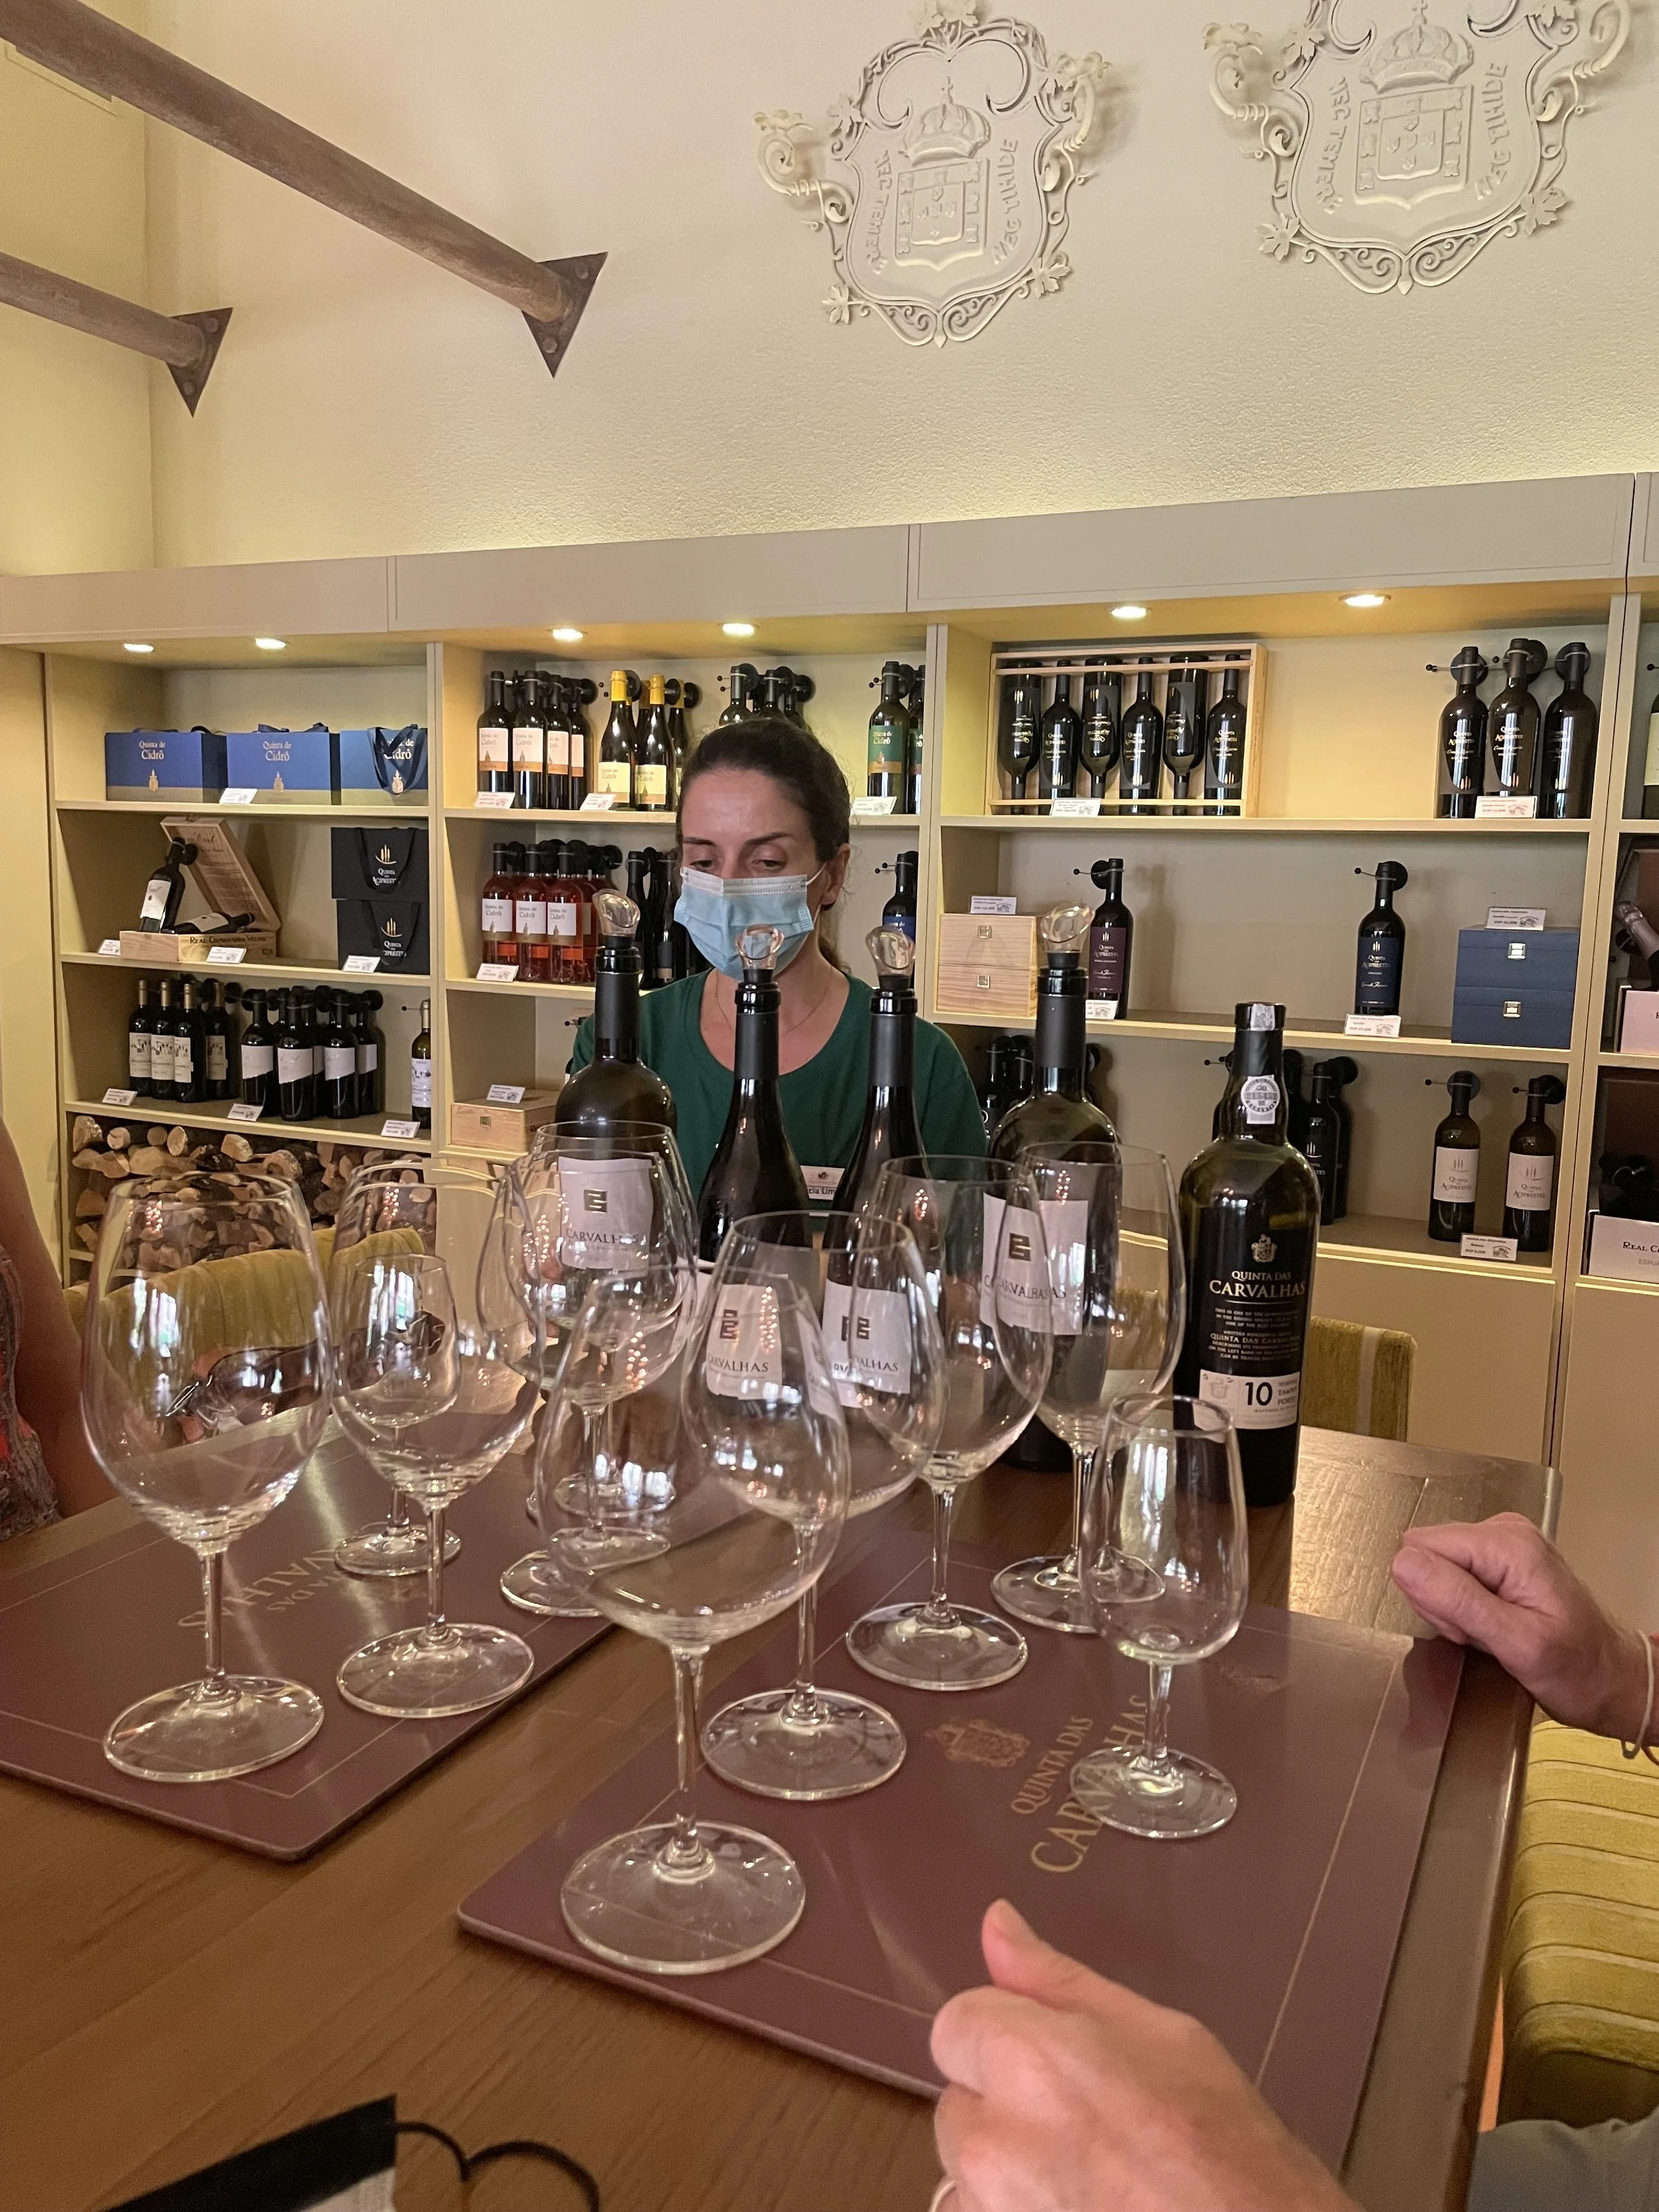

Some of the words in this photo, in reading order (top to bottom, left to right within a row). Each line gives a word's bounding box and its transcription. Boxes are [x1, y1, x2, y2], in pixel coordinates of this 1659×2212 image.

[139, 741, 158, 749] Quinta
[263, 741, 283, 750] Quinta
[141, 749, 165, 760] Cidrô
[265, 750, 290, 761] Cidrô
[566, 1228, 638, 1244] CARVALHS
[1623, 1242, 1648, 1252] REAL
[1232, 1270, 1273, 1282] QUINTA
[1274, 1272, 1291, 1281] DAS
[1209, 1280, 1307, 1298] CARVALHAS
[1210, 1333, 1240, 1343] QUINTA
[1245, 1382, 1273, 1406] 10
[1011, 1750, 1075, 1814] QUINTA
[1056, 1716, 1094, 1747] DAS
